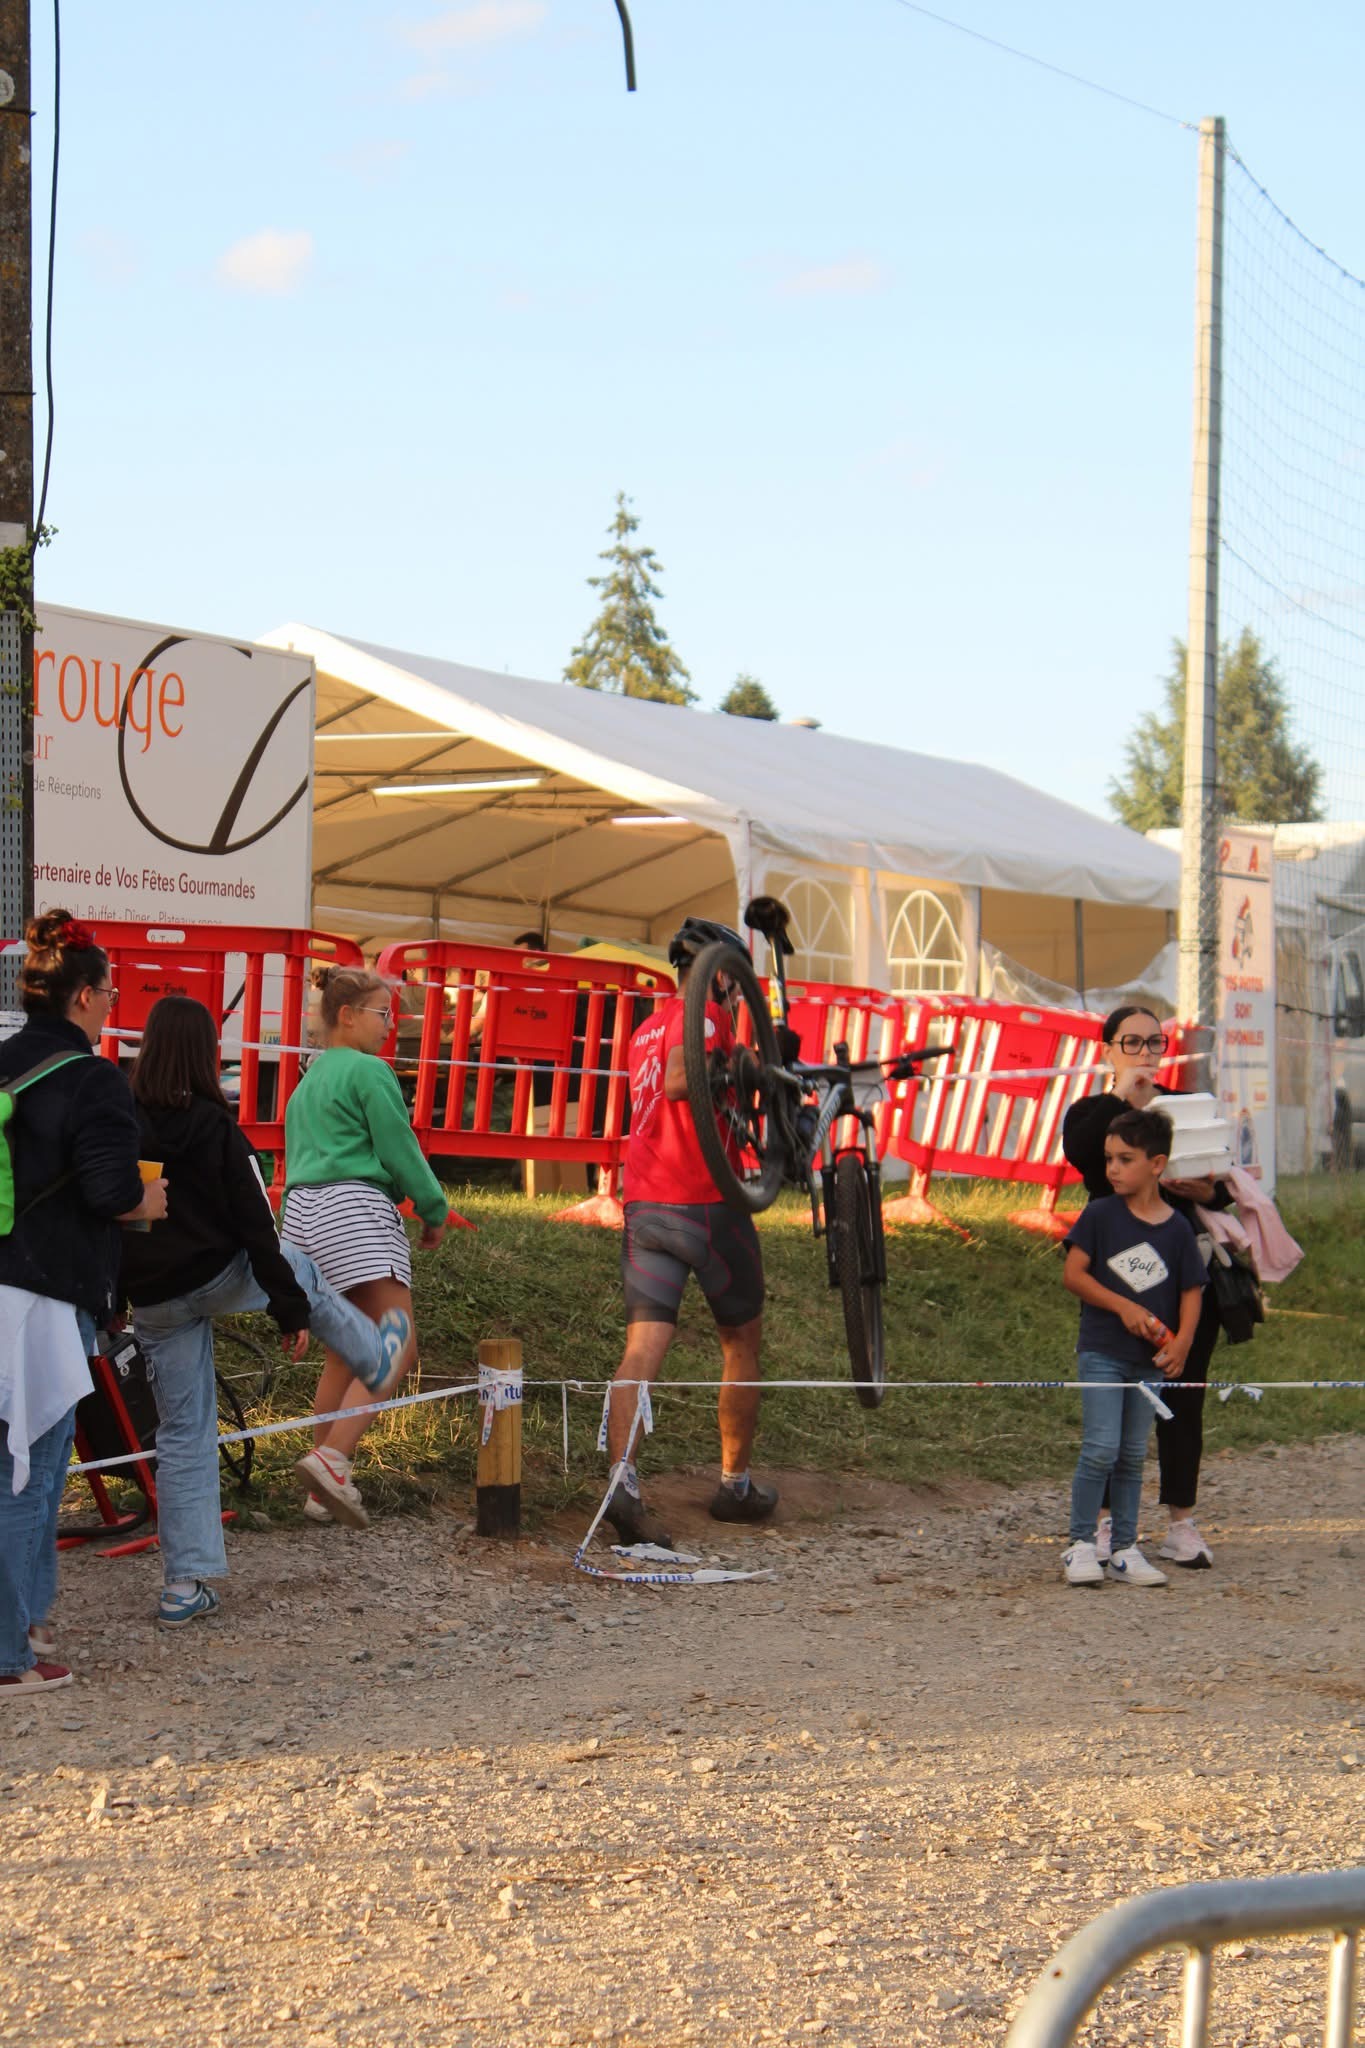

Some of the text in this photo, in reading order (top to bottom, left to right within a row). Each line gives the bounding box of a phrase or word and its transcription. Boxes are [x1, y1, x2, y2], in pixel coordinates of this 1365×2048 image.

[33, 649, 185, 754] rouge
[48, 776, 102, 801] Réceptions
[95, 863, 112, 887] de
[116, 866, 138, 889] Vos
[142, 868, 175, 893] Fêtes
[178, 872, 256, 900] Gourmandes
[1128, 1256, 1157, 1275] Golf
